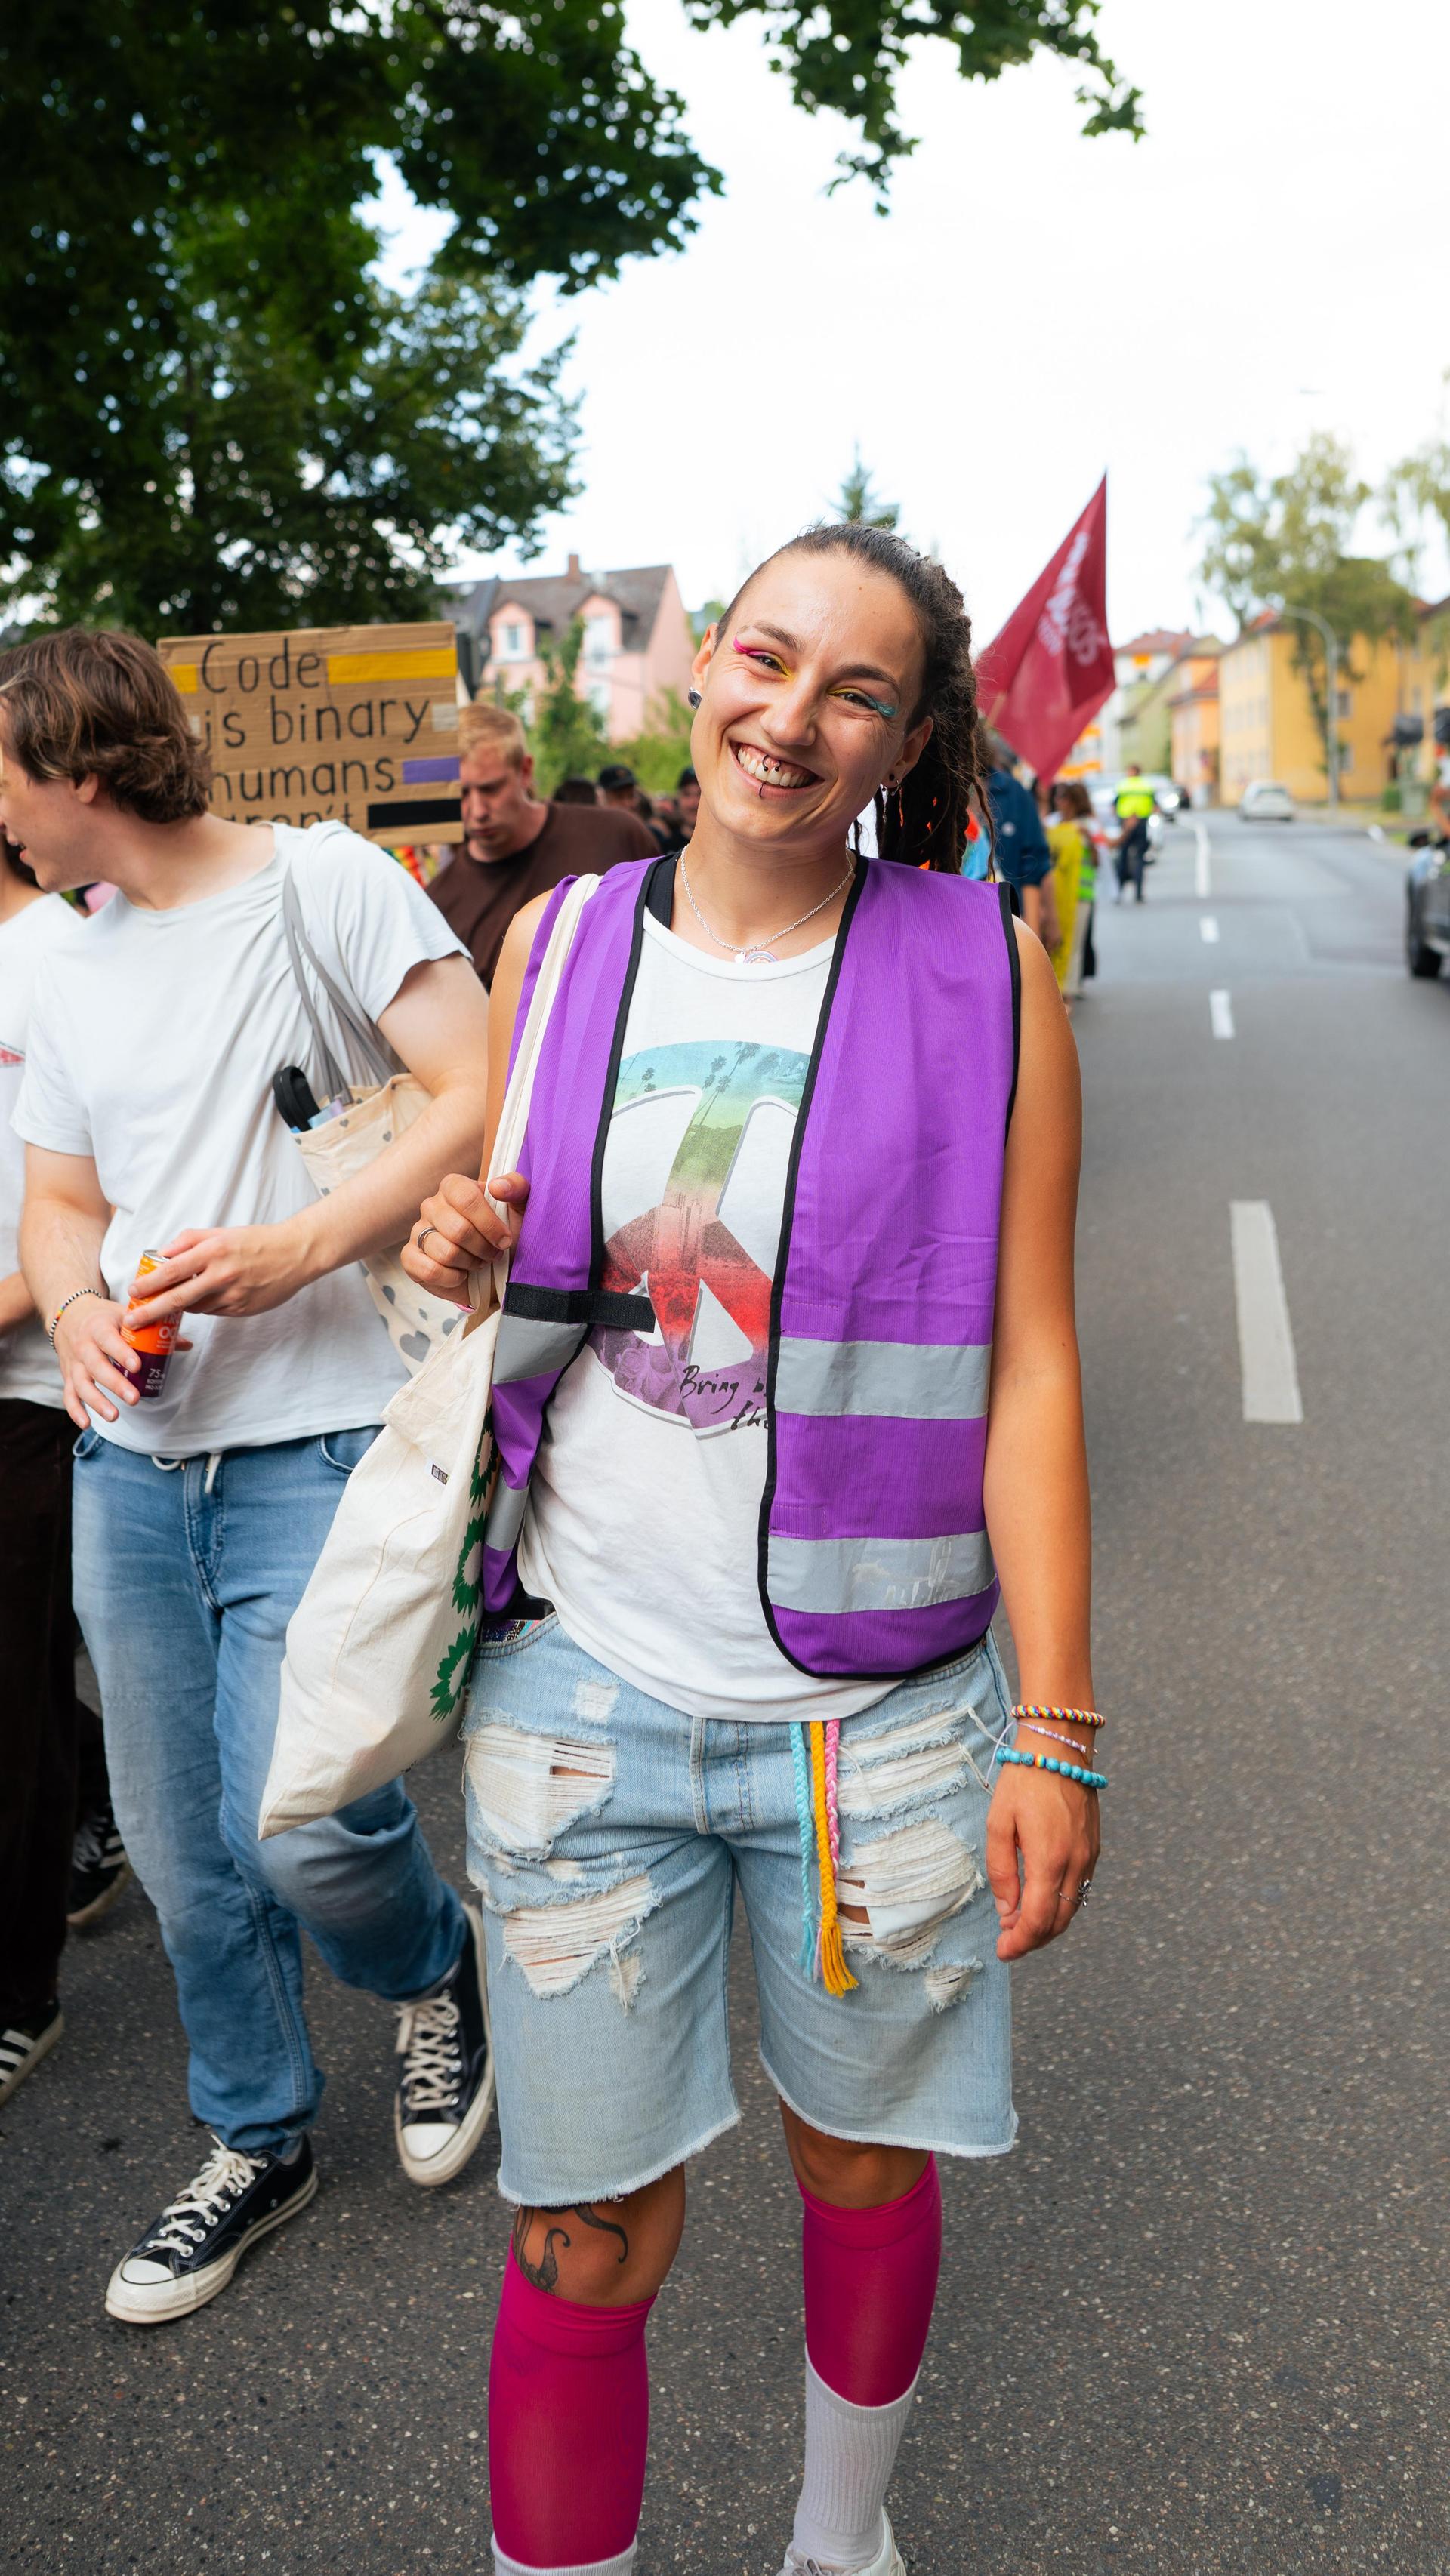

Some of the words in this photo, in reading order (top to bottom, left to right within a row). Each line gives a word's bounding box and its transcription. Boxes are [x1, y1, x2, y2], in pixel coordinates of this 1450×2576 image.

[201, 638, 321, 694] Code
[205, 710, 246, 748] is
[270, 695, 430, 745] binary
[680, 1365, 739, 1415] Bring
